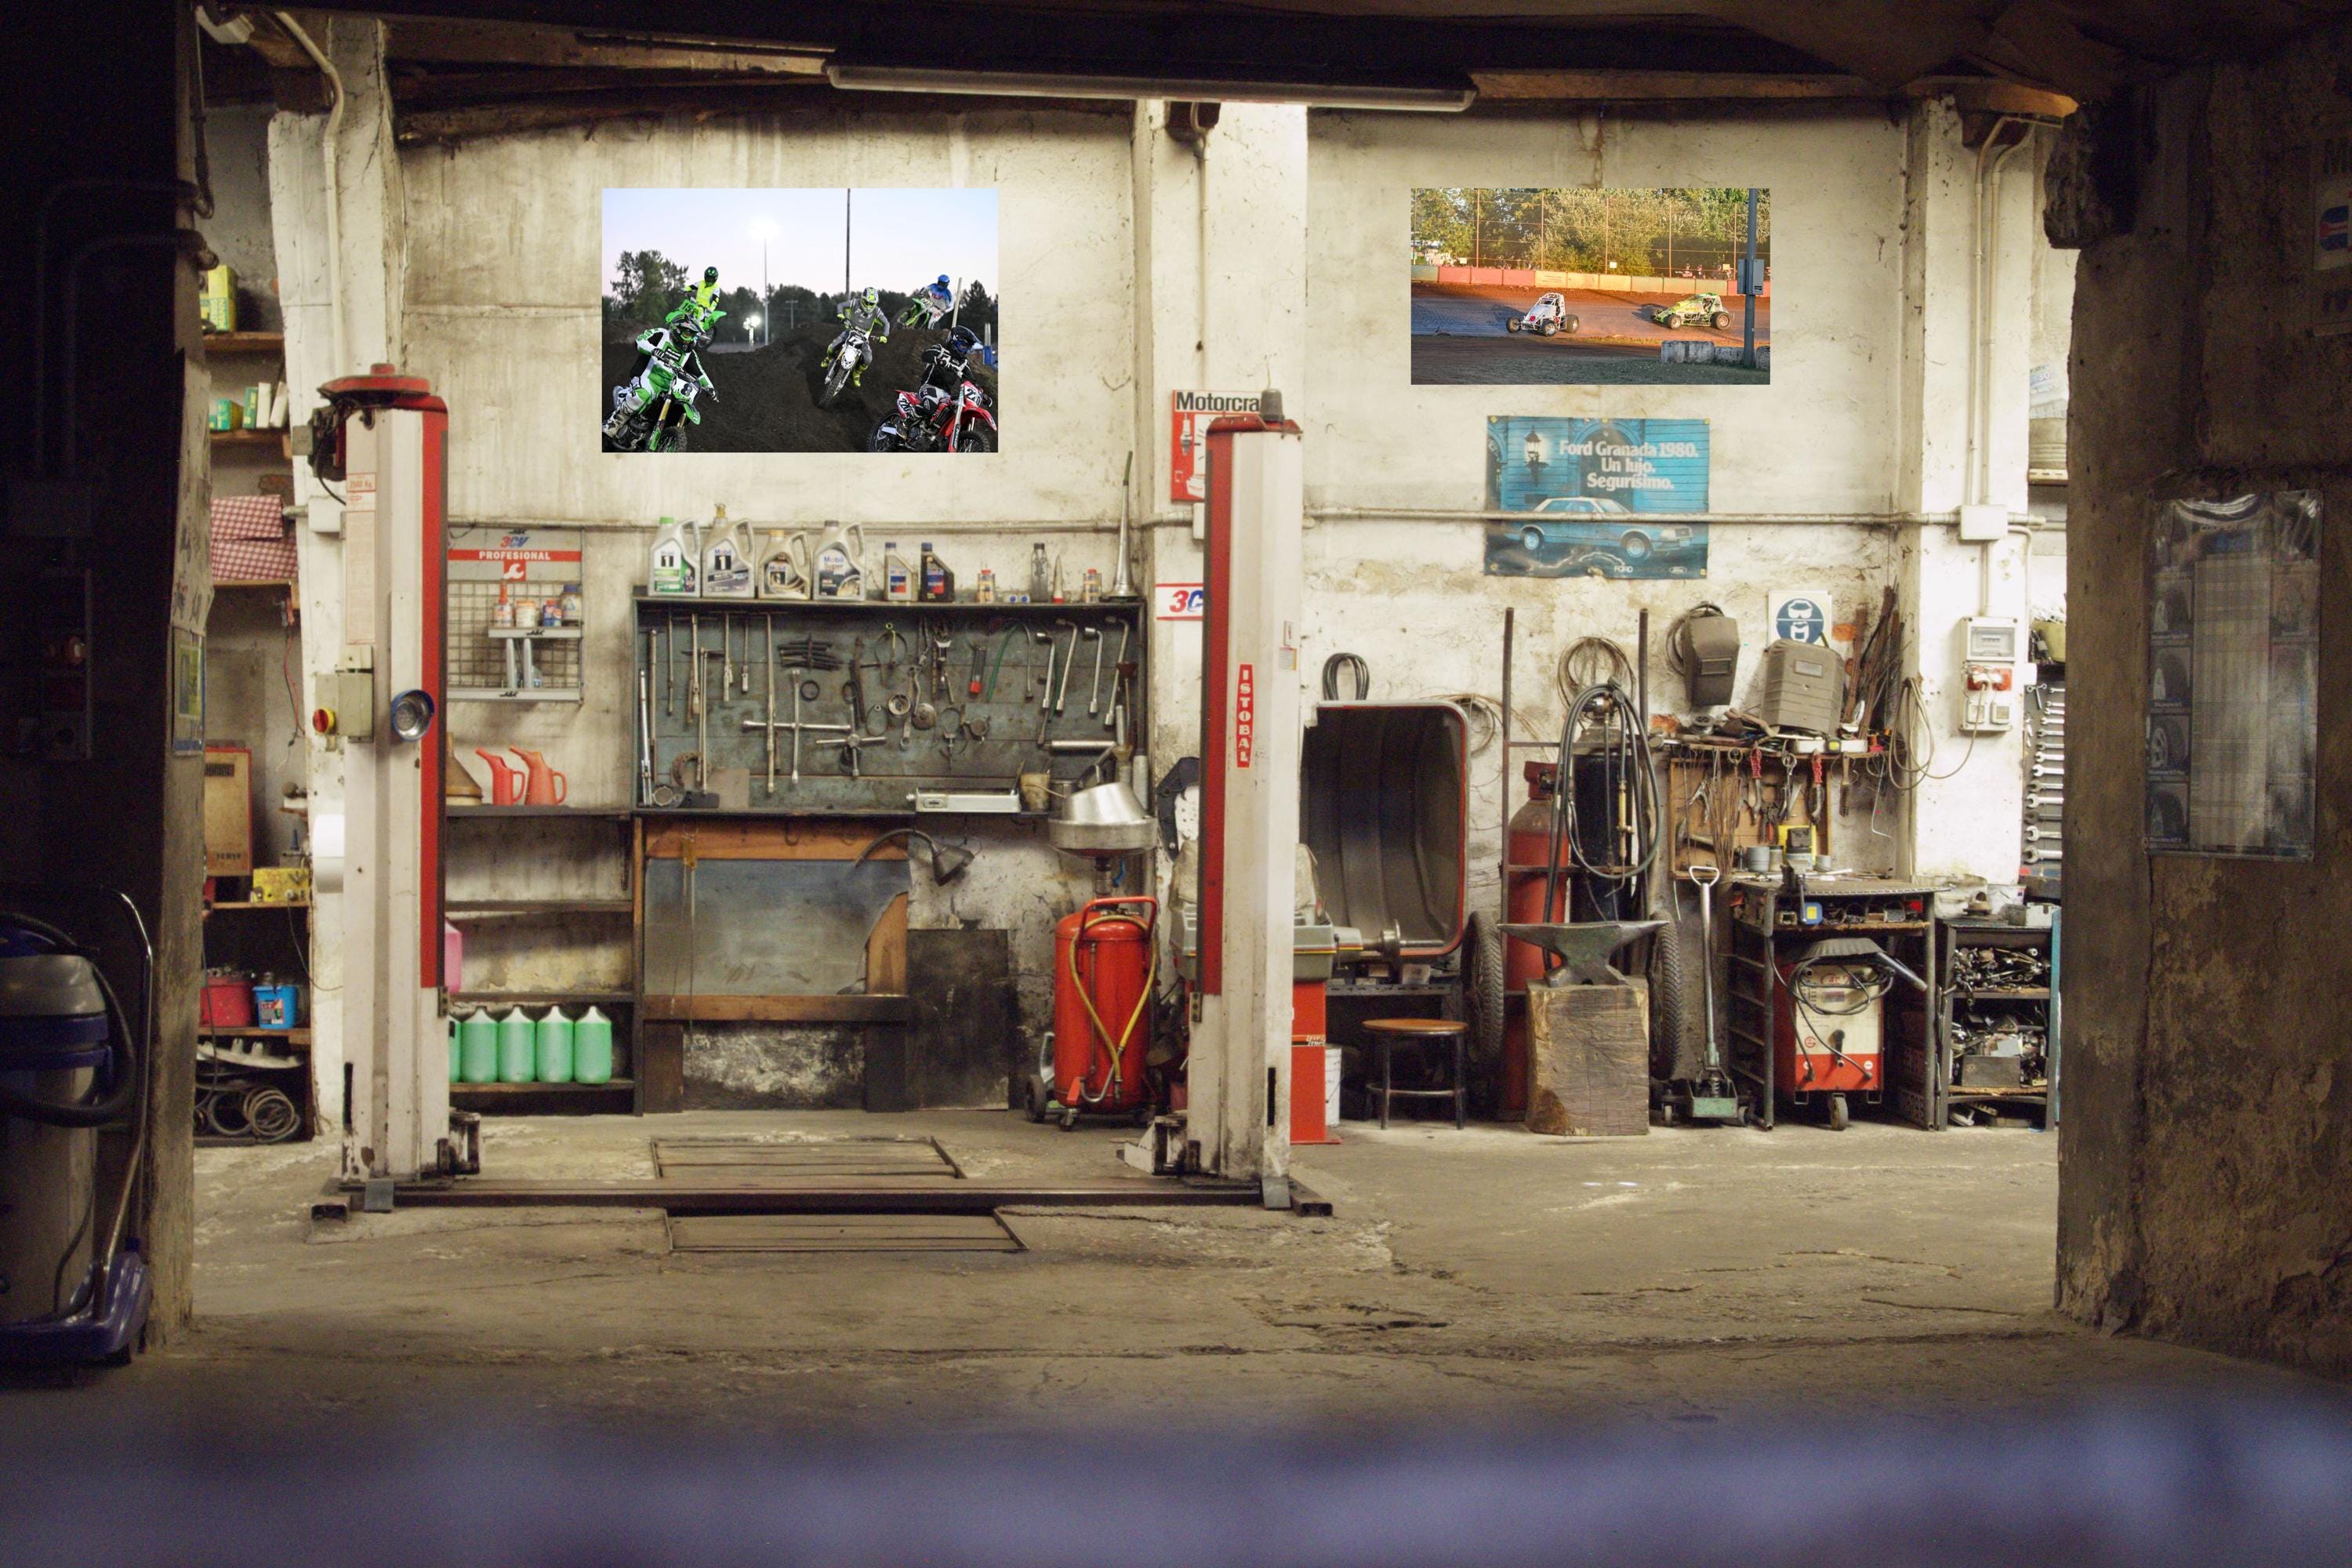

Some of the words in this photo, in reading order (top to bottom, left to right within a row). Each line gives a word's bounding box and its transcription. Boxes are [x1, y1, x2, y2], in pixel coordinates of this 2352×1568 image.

[681, 383, 693, 397] 8
[1176, 391, 1259, 412] Motorcra
[1559, 440, 1593, 456] Ford
[1595, 441, 1657, 457] Granada
[1658, 442, 1699, 458] 1980.
[1601, 457, 1621, 473] Un
[1625, 457, 1656, 476] lujo.
[478, 551, 551, 560] PROFESIONAL
[1170, 590, 1203, 612] 3C
[1238, 669, 1251, 762] ISTOBAL
